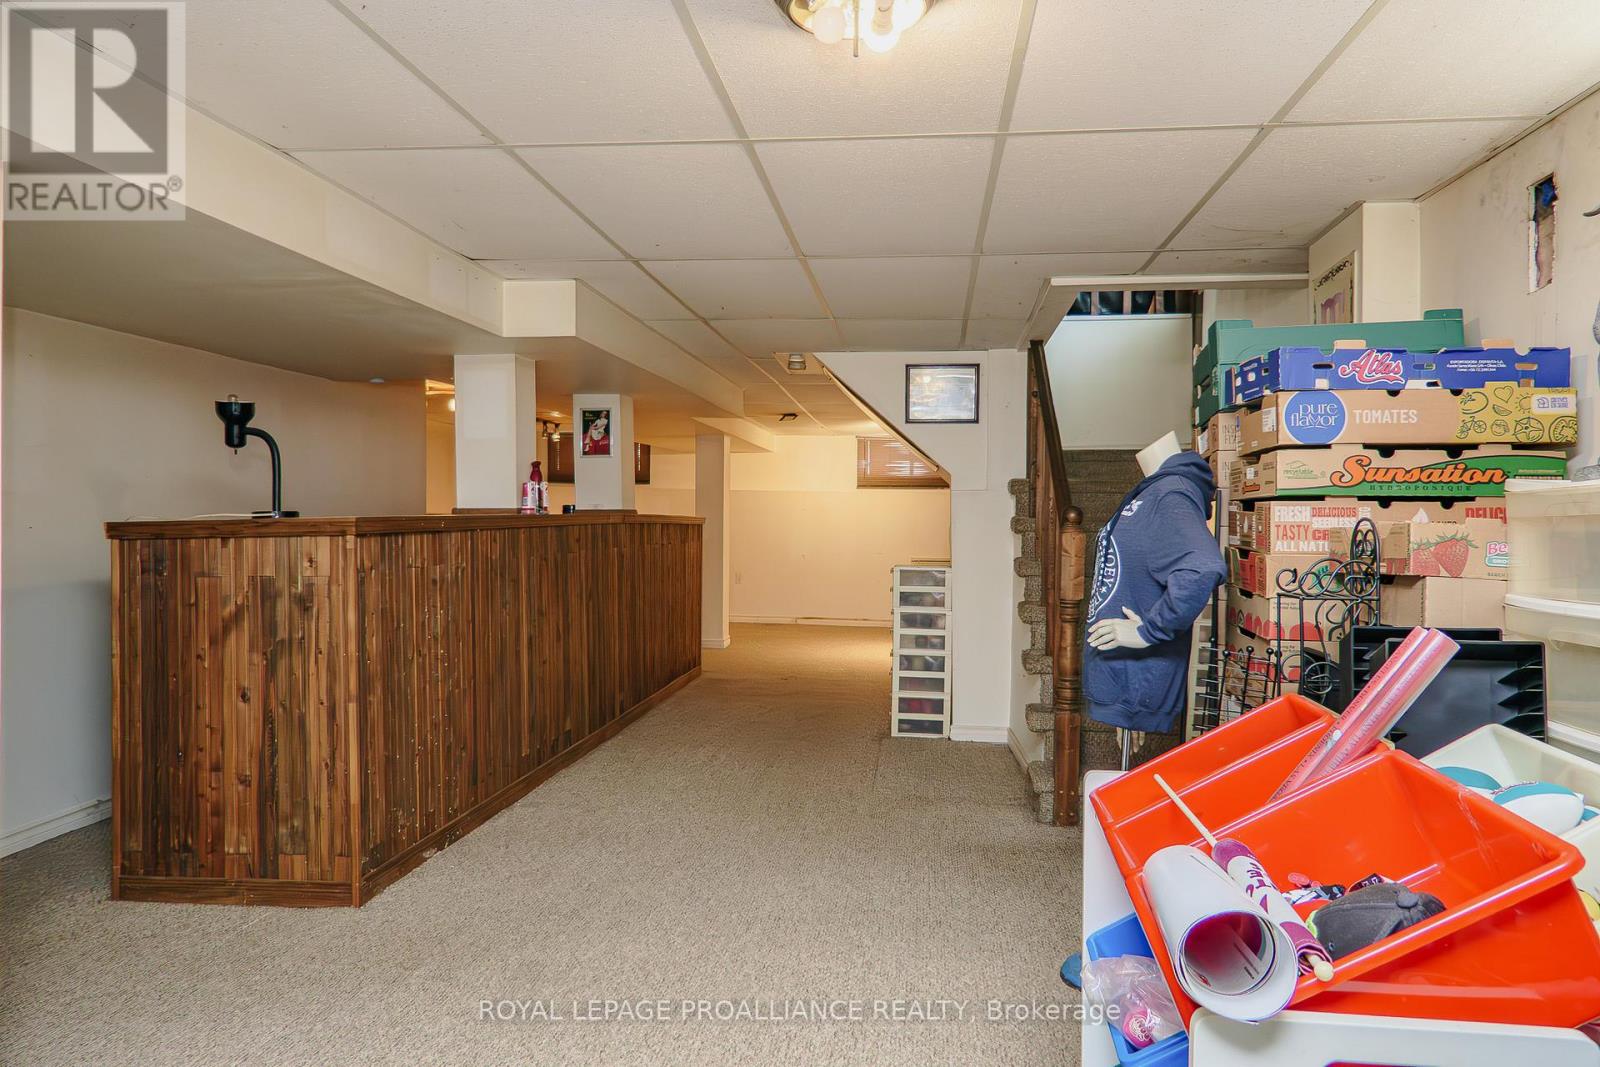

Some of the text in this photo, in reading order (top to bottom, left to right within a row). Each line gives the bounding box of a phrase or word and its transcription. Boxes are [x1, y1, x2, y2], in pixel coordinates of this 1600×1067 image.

[1338, 349, 1405, 384] Atlas
[1299, 403, 1338, 417] pure
[1353, 409, 1418, 424] TOMATES
[1290, 412, 1338, 427] flavor
[1330, 455, 1508, 488] Sunsation
[1274, 506, 1311, 522] FRESH
[1311, 507, 1357, 518] DELICIOUS
[1275, 524, 1310, 541] TASTY
[1275, 541, 1298, 552] ALL
